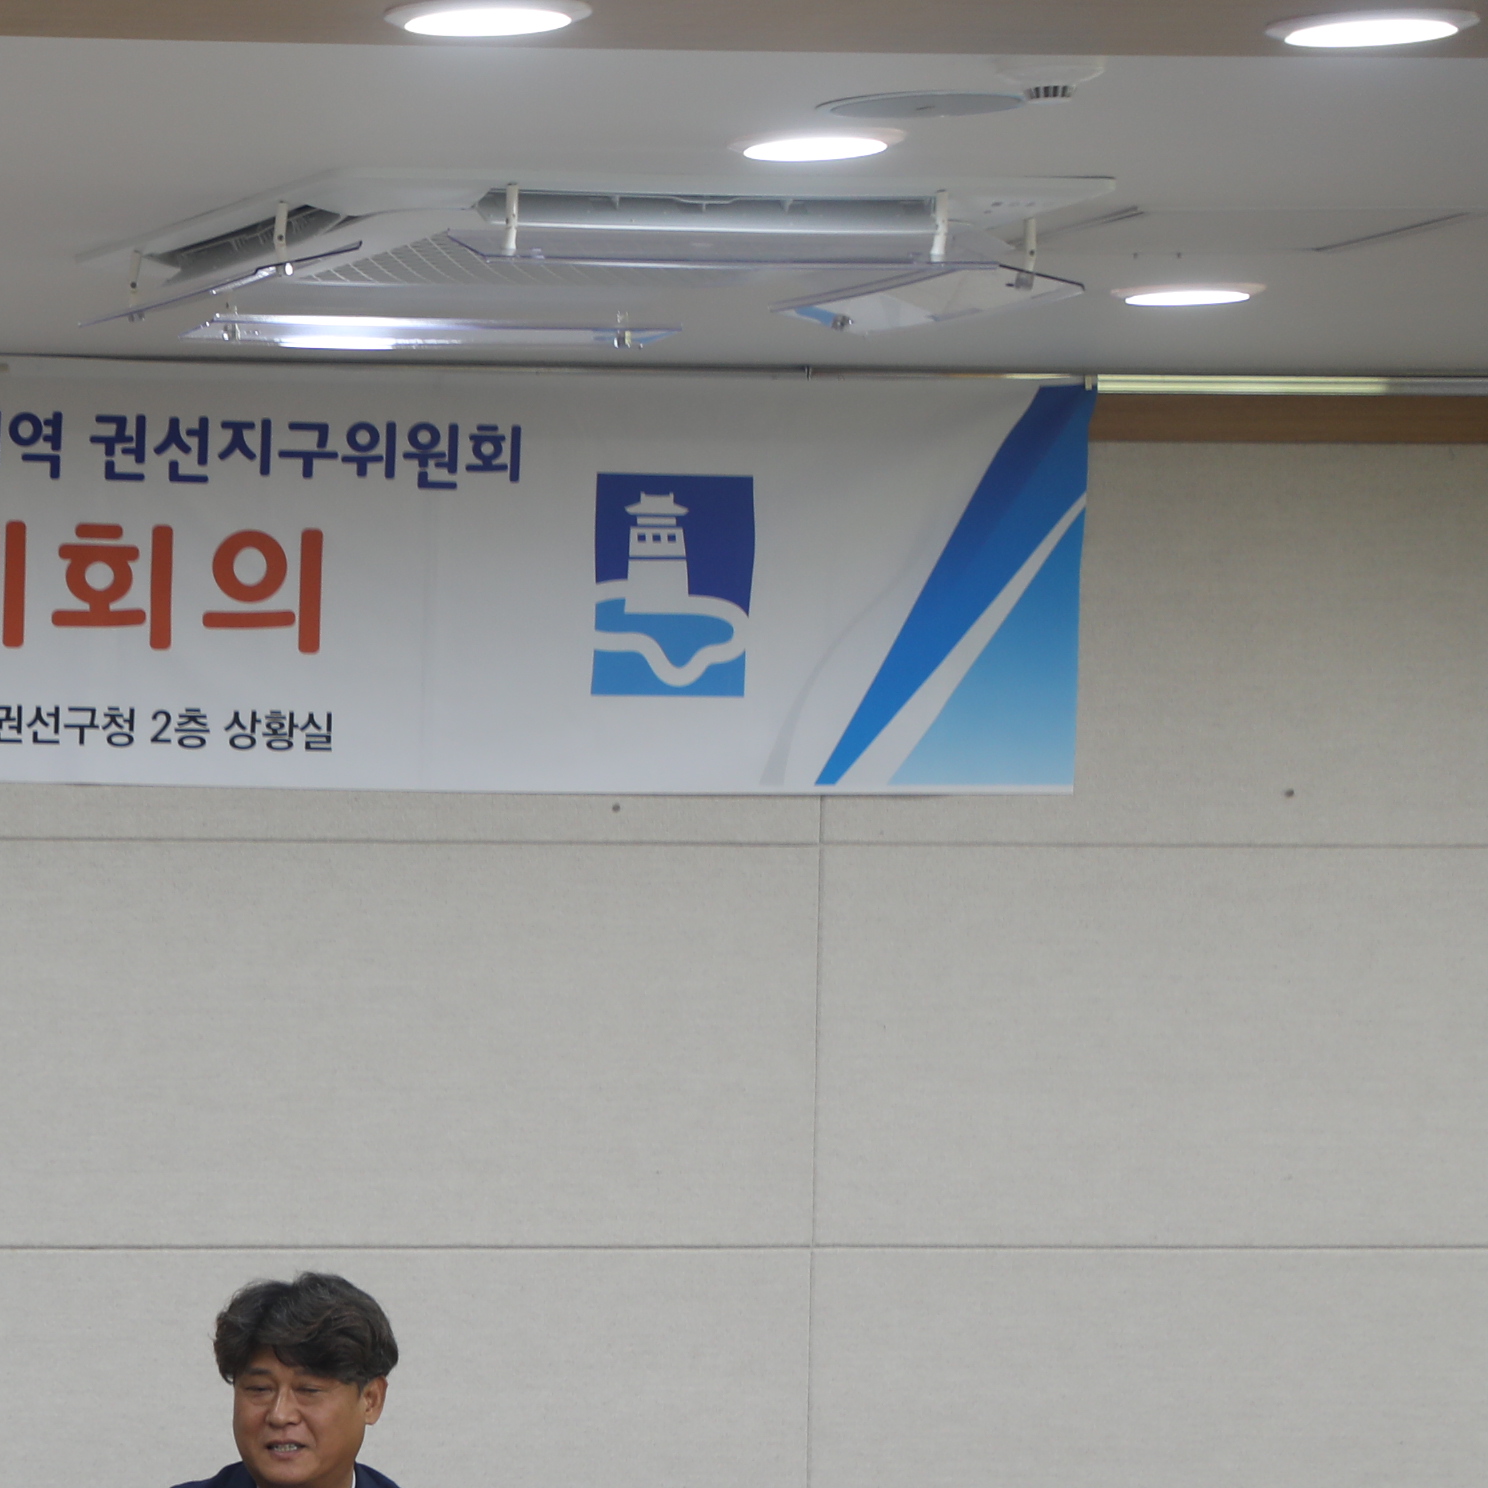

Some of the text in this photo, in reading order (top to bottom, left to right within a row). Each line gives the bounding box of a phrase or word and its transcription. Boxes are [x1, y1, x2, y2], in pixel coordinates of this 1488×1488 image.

[89, 414, 522, 490] 권선지구위원회
[150, 707, 211, 750] 2층
[224, 709, 333, 752] 상황실
